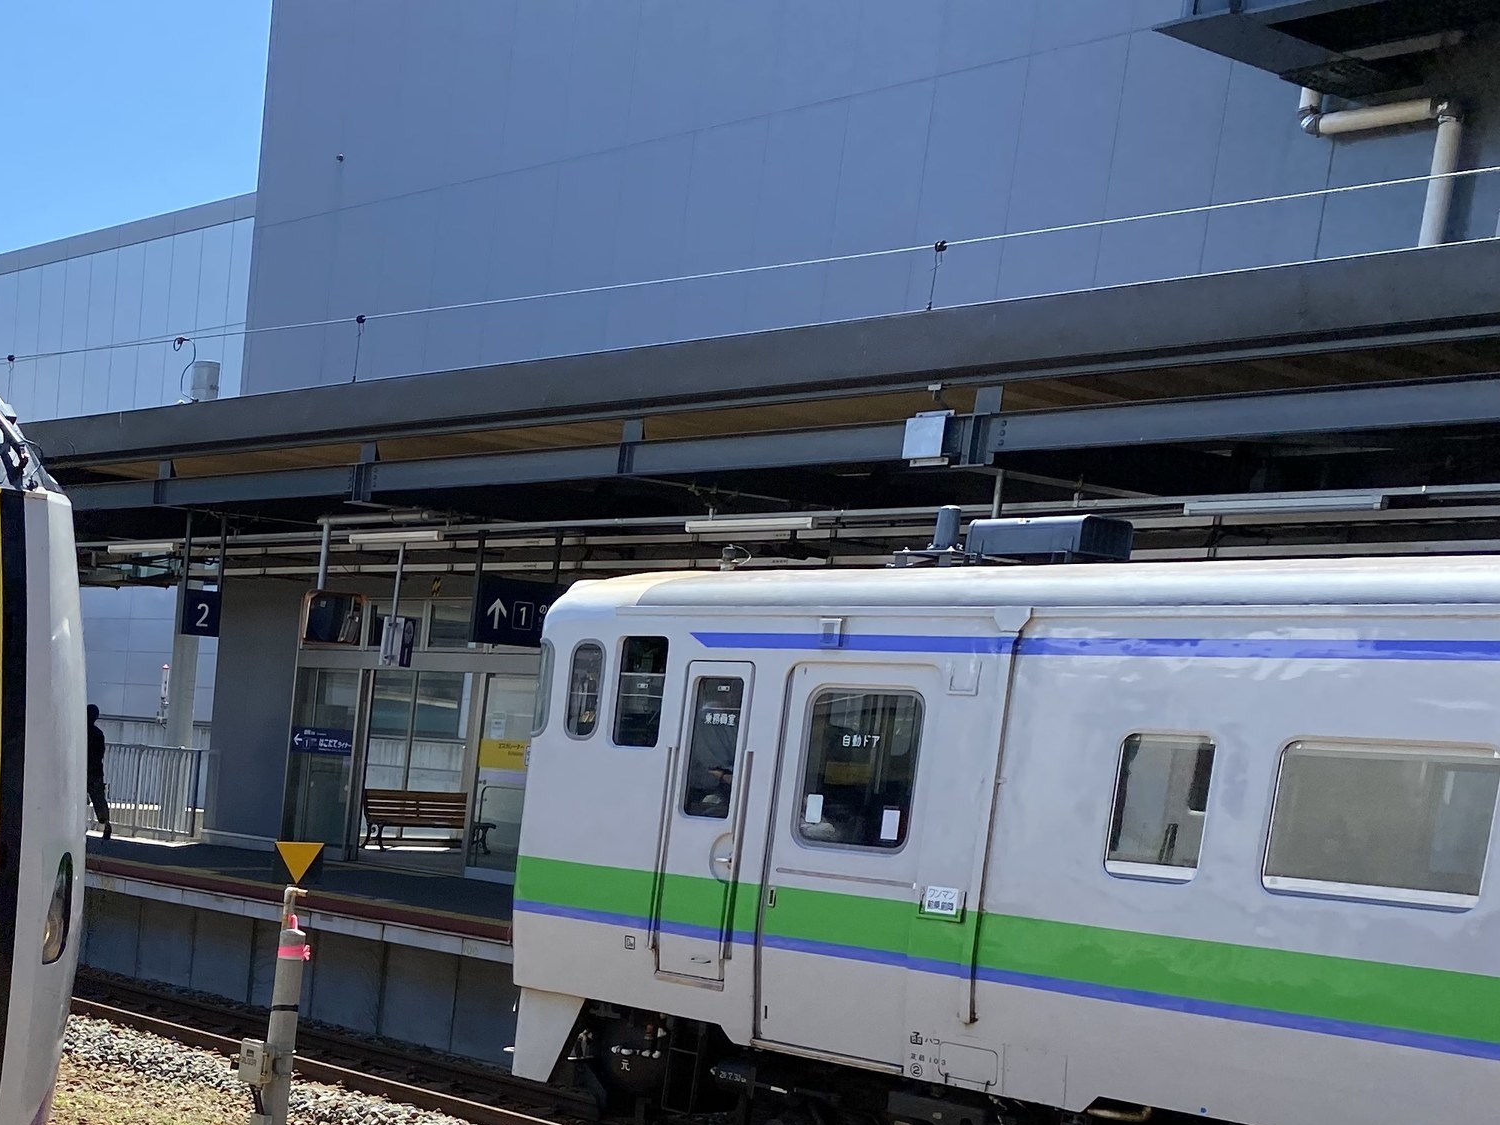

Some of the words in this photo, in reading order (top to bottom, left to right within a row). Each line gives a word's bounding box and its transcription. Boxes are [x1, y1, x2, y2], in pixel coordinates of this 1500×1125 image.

[195, 603, 209, 627] 2
[520, 606, 527, 626] 1
[842, 734, 881, 748] 自動ドア
[928, 888, 957, 900] ワンマン
[620, 1059, 631, 1071] 元
